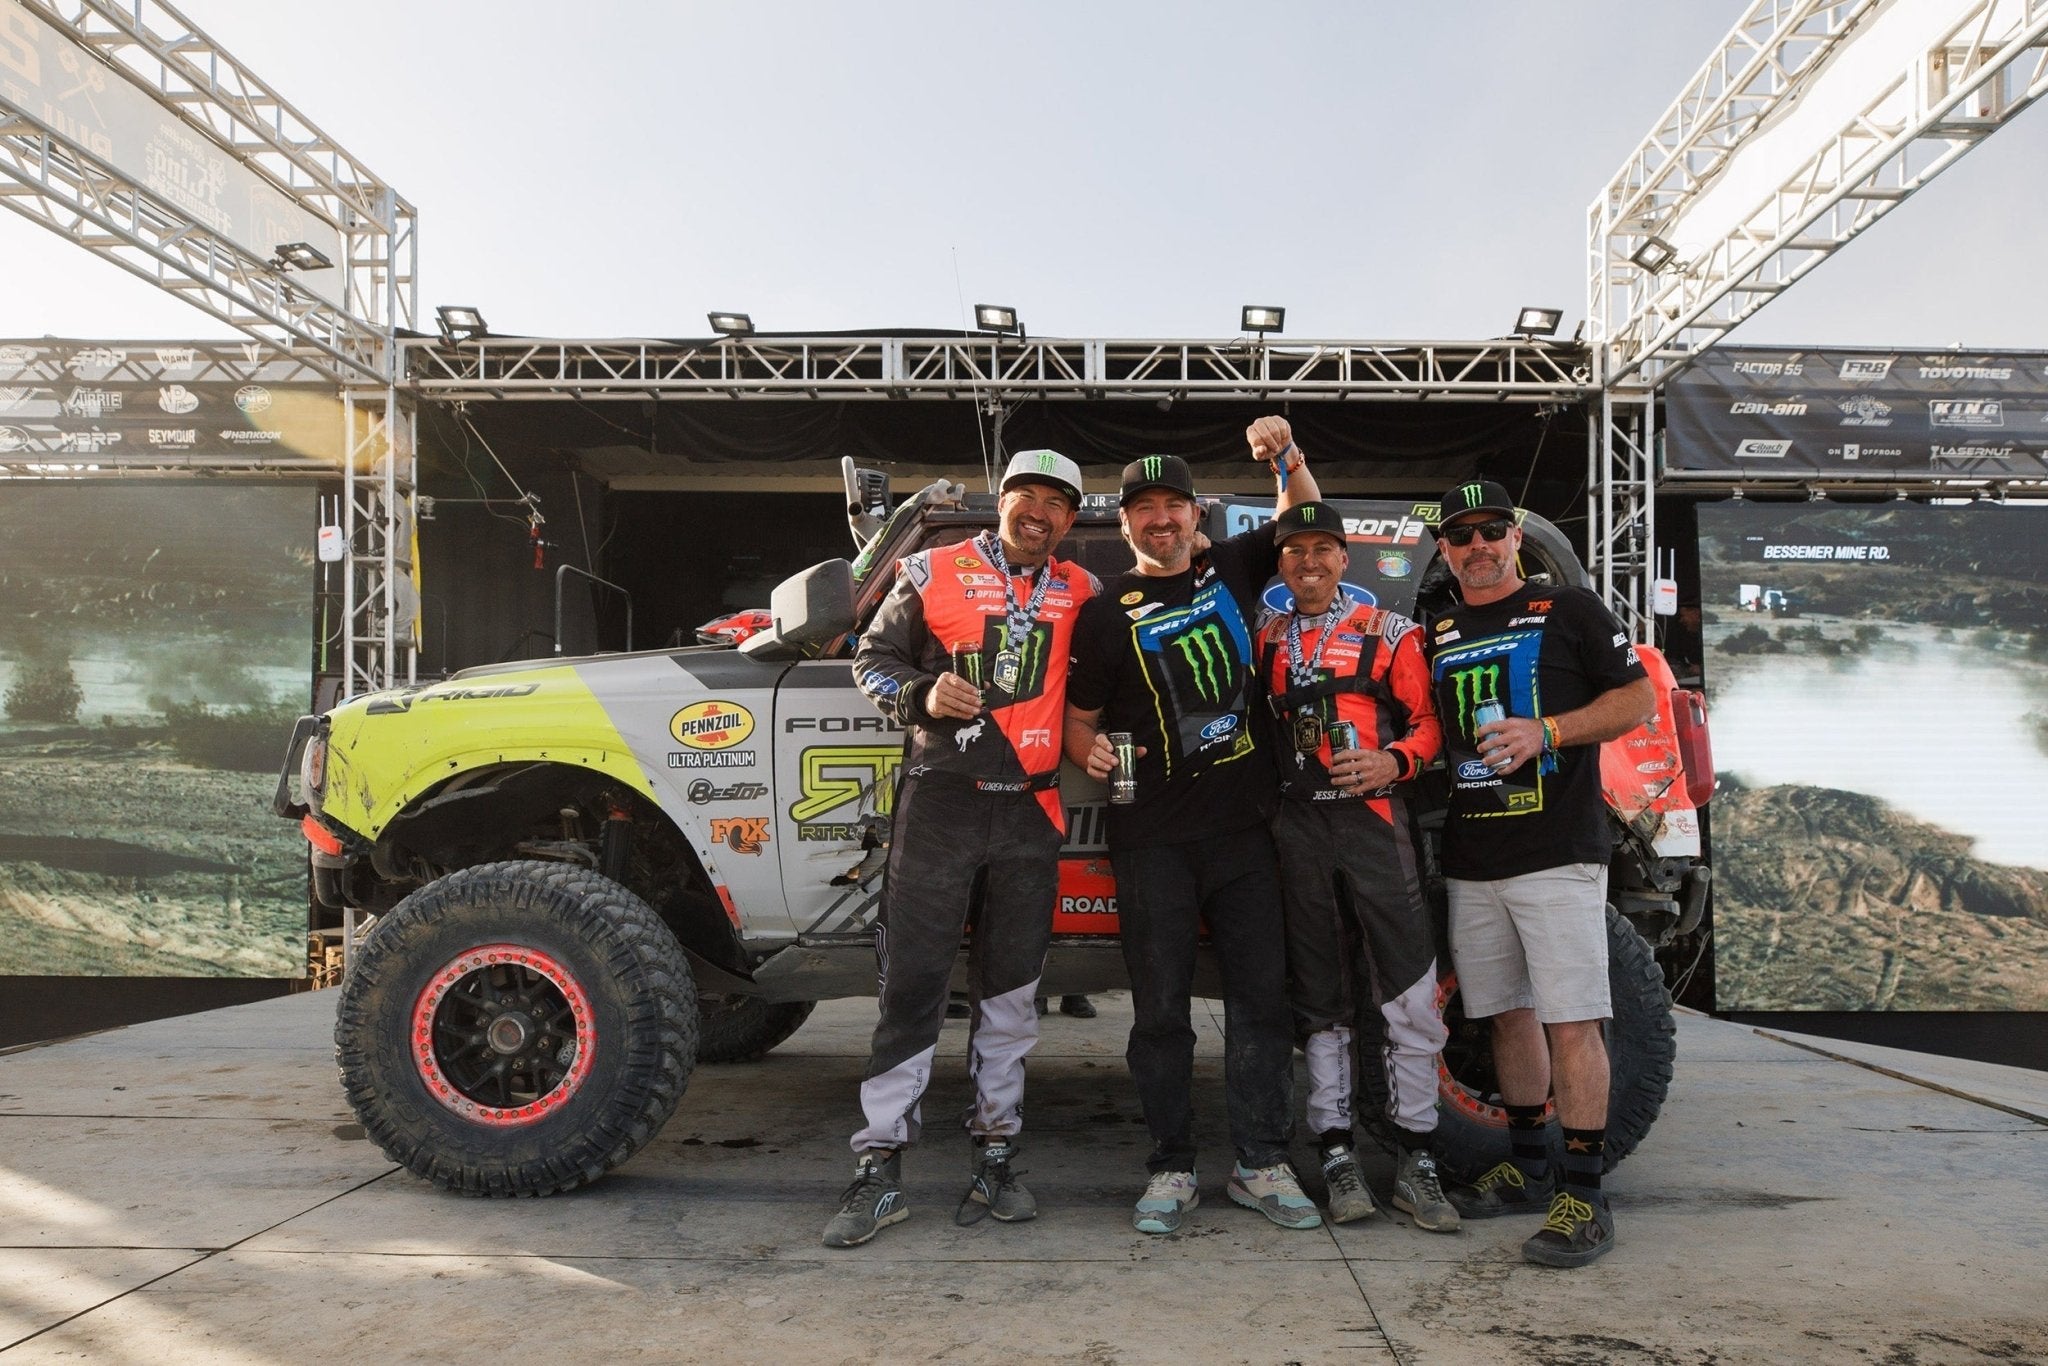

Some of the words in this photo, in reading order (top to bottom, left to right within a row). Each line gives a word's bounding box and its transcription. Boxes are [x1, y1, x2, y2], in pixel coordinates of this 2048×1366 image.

[161, 355, 189, 363] WARN
[1732, 362, 1781, 375] FACTOR
[1844, 361, 1886, 374] FR8
[237, 395, 270, 405] EMPI
[1729, 402, 1808, 416] can-am
[1933, 403, 1999, 416] KING
[148, 429, 196, 444] SEYMOUR
[1862, 448, 1903, 456] OFFROAD
[1939, 446, 2014, 457] LASERNUT
[1764, 545, 1833, 560] BESSEMER
[1835, 545, 1868, 560] MINE
[1868, 545, 1891, 560] RD.
[1527, 600, 1554, 614] FOX
[1149, 600, 1216, 635] NITTO
[1518, 615, 1547, 625] OPTIMA
[1440, 642, 1519, 664] NITTO
[420, 683, 542, 703] RIGID
[681, 713, 745, 737] PENNZOIL
[1209, 718, 1232, 736] Ford
[669, 752, 701, 767] ULTRA
[703, 751, 754, 767] PLATINUM
[1463, 763, 1489, 777] Ford
[980, 781, 1003, 791] LOREN
[1457, 778, 1503, 790] RACING
[1312, 790, 1338, 800] JESSE
[710, 816, 770, 853] FOX
[799, 824, 848, 841] RTR
